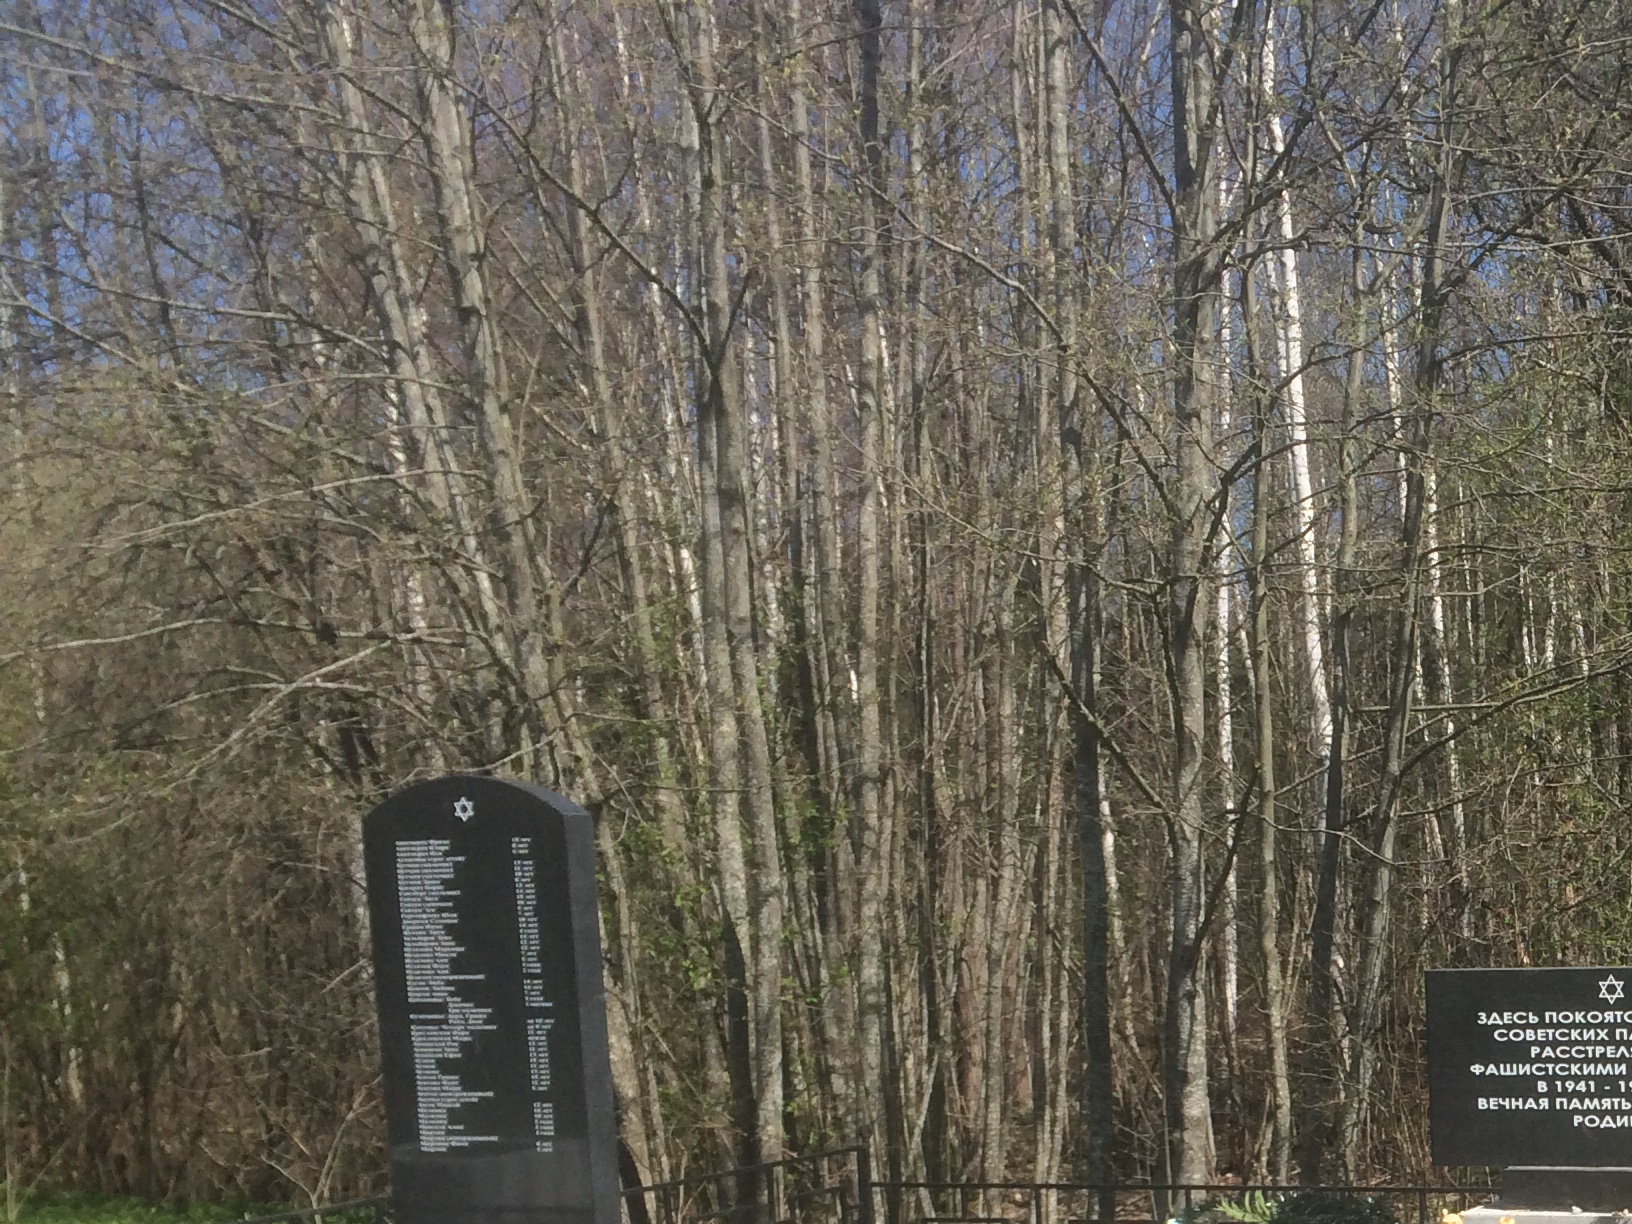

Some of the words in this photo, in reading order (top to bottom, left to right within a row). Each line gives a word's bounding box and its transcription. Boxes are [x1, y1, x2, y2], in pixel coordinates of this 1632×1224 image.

[1477, 1012, 1539, 1025] ЗДЕСЬ
[1494, 1028, 1609, 1041] СОВЕТСКИХ
[1470, 1063, 1627, 1076] ФАШИСТСКИМИ
[1537, 1080, 1548, 1093] В
[1555, 1080, 1596, 1093] 1941
[1477, 1098, 1549, 1110] ВЕЧНАЯ
[1555, 1098, 1632, 1110] ПАМЯТЬ
